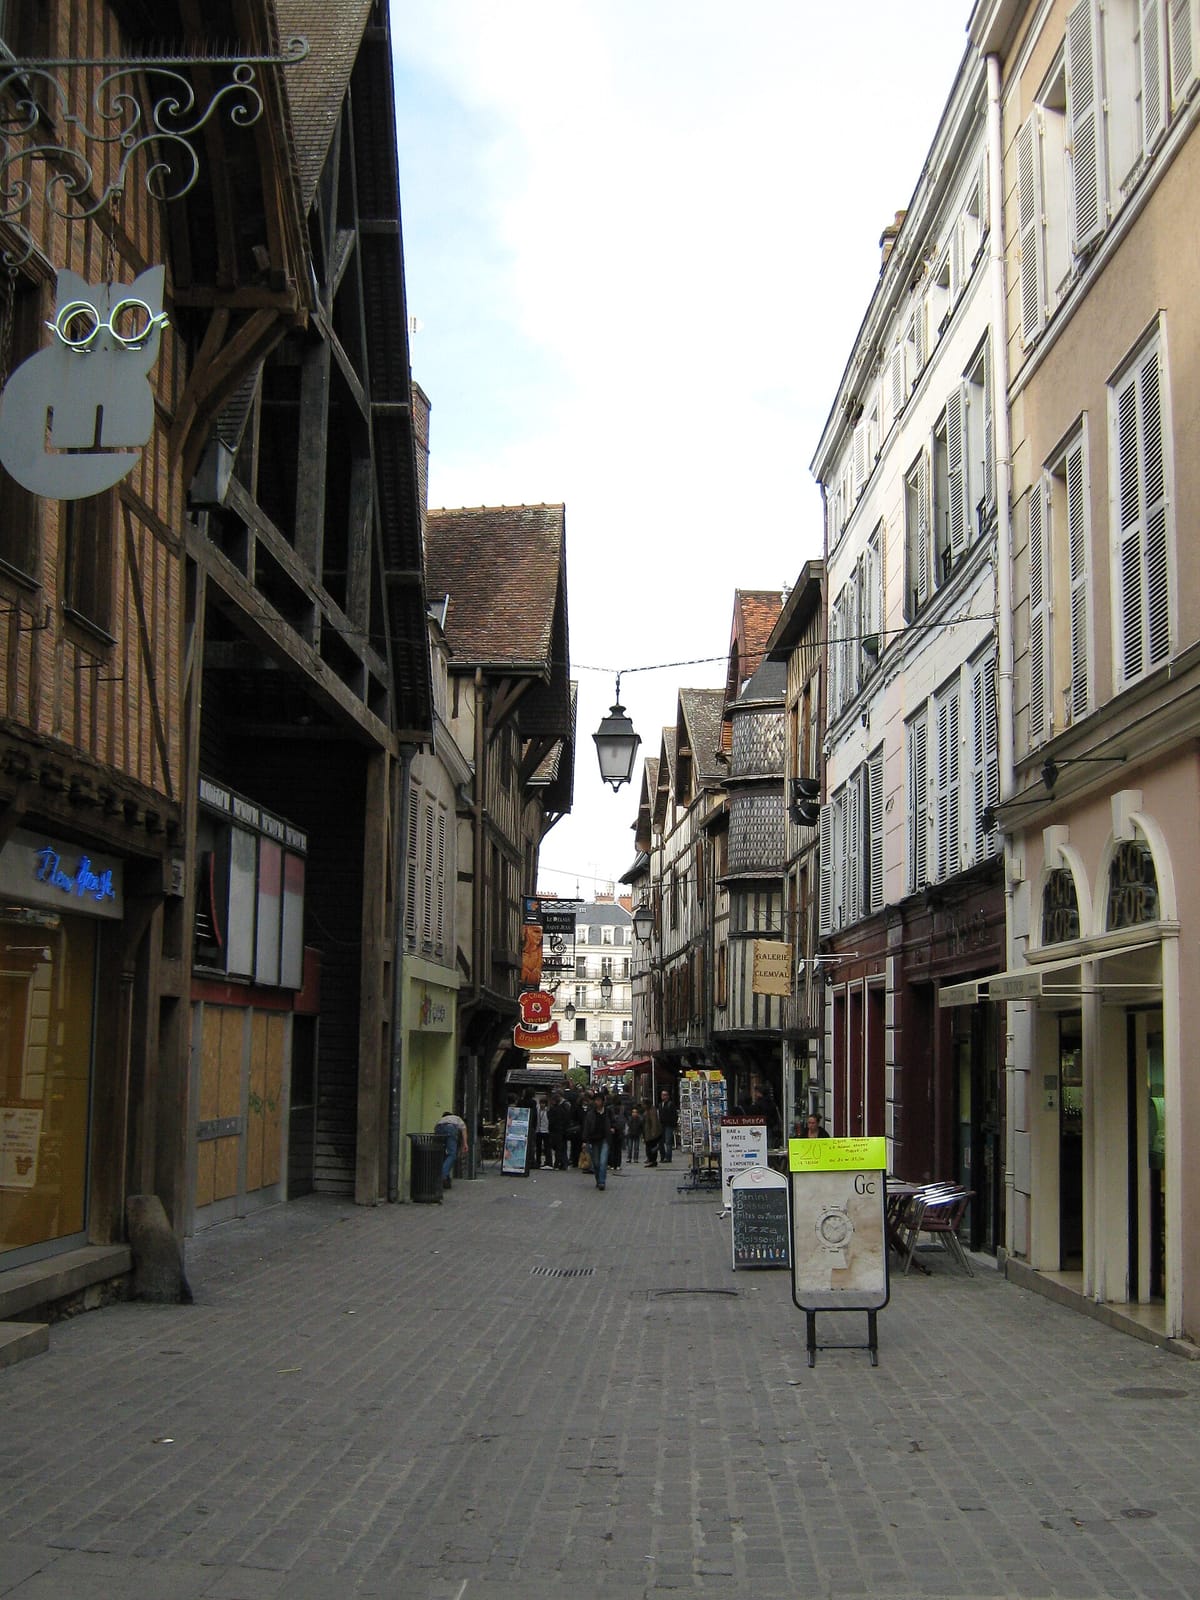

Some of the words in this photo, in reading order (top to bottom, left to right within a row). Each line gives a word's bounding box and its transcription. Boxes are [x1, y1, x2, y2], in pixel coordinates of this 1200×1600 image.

[755, 953, 789, 961] GALERIE
[755, 970, 789, 978] CLEMVAL
[854, 1174, 875, 1195] Gc
